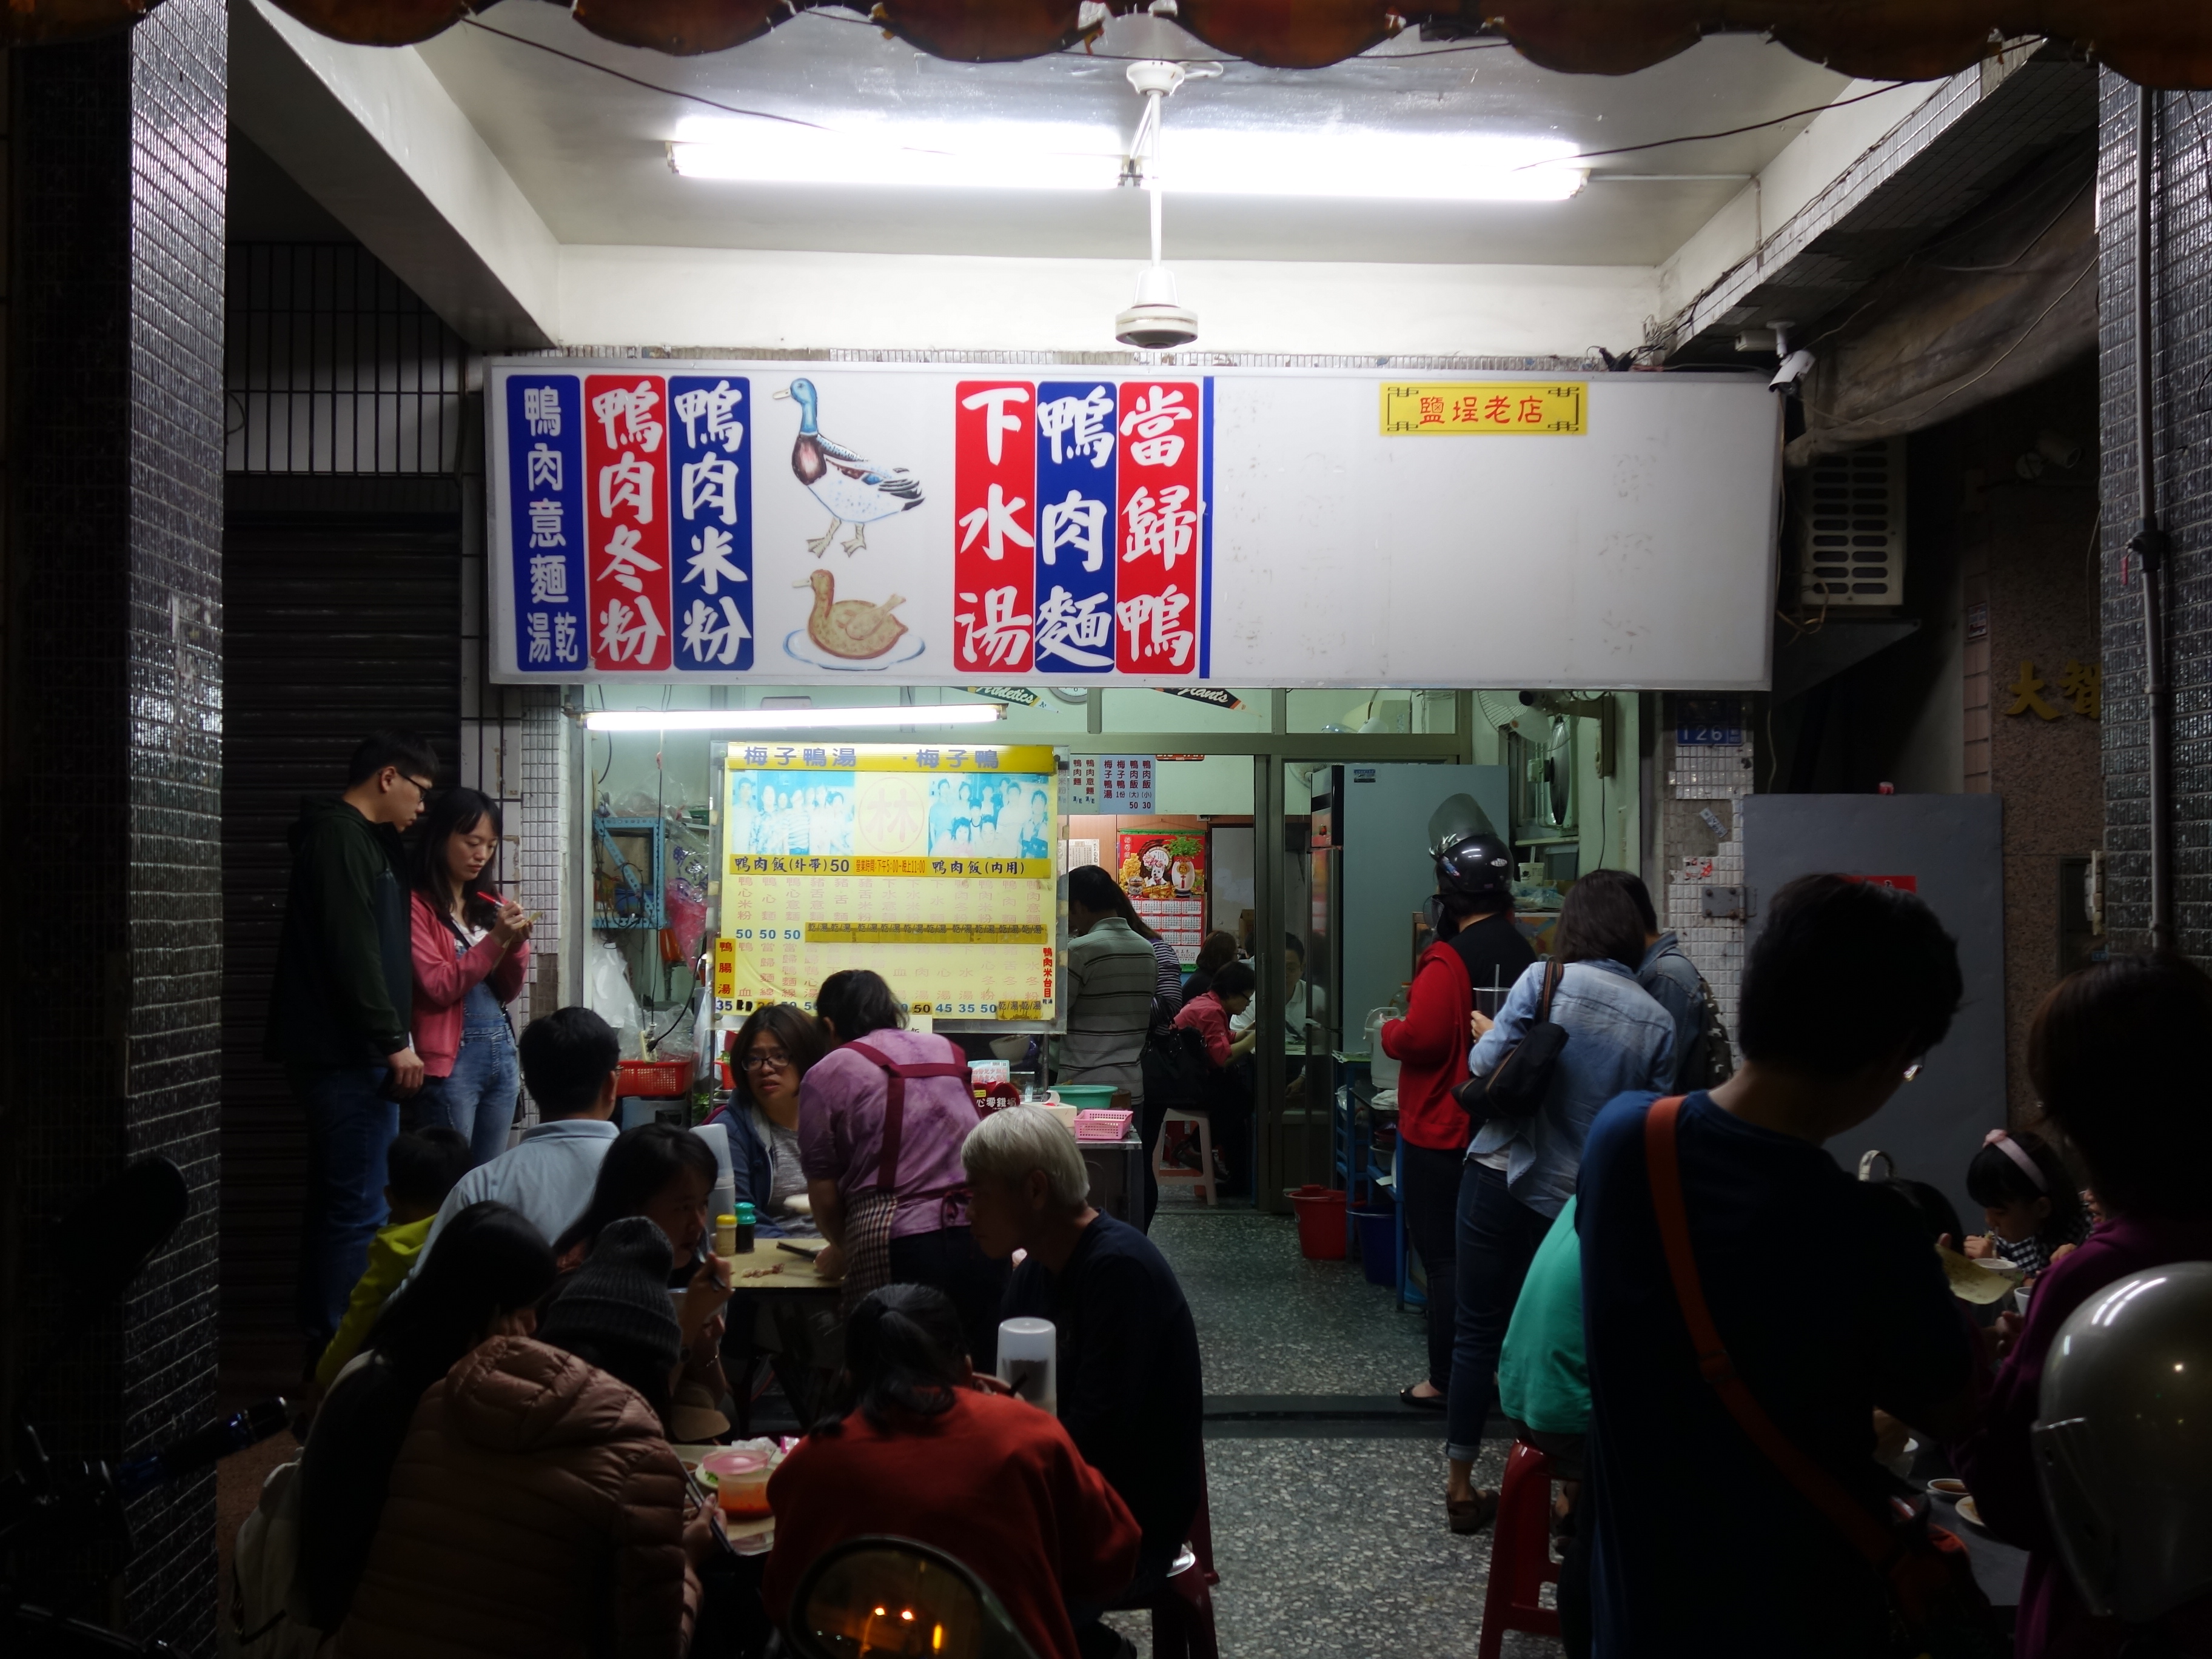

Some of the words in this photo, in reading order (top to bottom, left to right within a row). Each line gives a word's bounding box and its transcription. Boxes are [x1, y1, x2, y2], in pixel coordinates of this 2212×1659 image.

[1419, 395, 1543, 424] 鹽埕老店
[592, 380, 666, 665] 鴨肉冬粉
[674, 380, 752, 665] 鴨肉米粉
[955, 387, 1035, 667] 下水湯
[1034, 385, 1115, 667] 鴨肉麵
[1116, 385, 1196, 666] 當歸鴨
[1683, 725, 1723, 741] 126
[744, 746, 856, 767] 梅子鴨湯
[1104, 760, 1112, 799] 梅子鴨湯
[866, 788, 918, 842] 林
[737, 877, 752, 920] 鴨心米粉
[736, 929, 752, 939] 50
[759, 930, 776, 939] 50
[784, 930, 800, 939] 50
[718, 942, 732, 994] 鴨腸湯
[1043, 947, 1053, 997] 鴨肉米台目
[716, 1000, 732, 1011] 35
[914, 1004, 930, 1013] 50
[936, 1004, 952, 1013] 45
[959, 1004, 975, 1013] 35
[980, 1004, 997, 1013] 50
